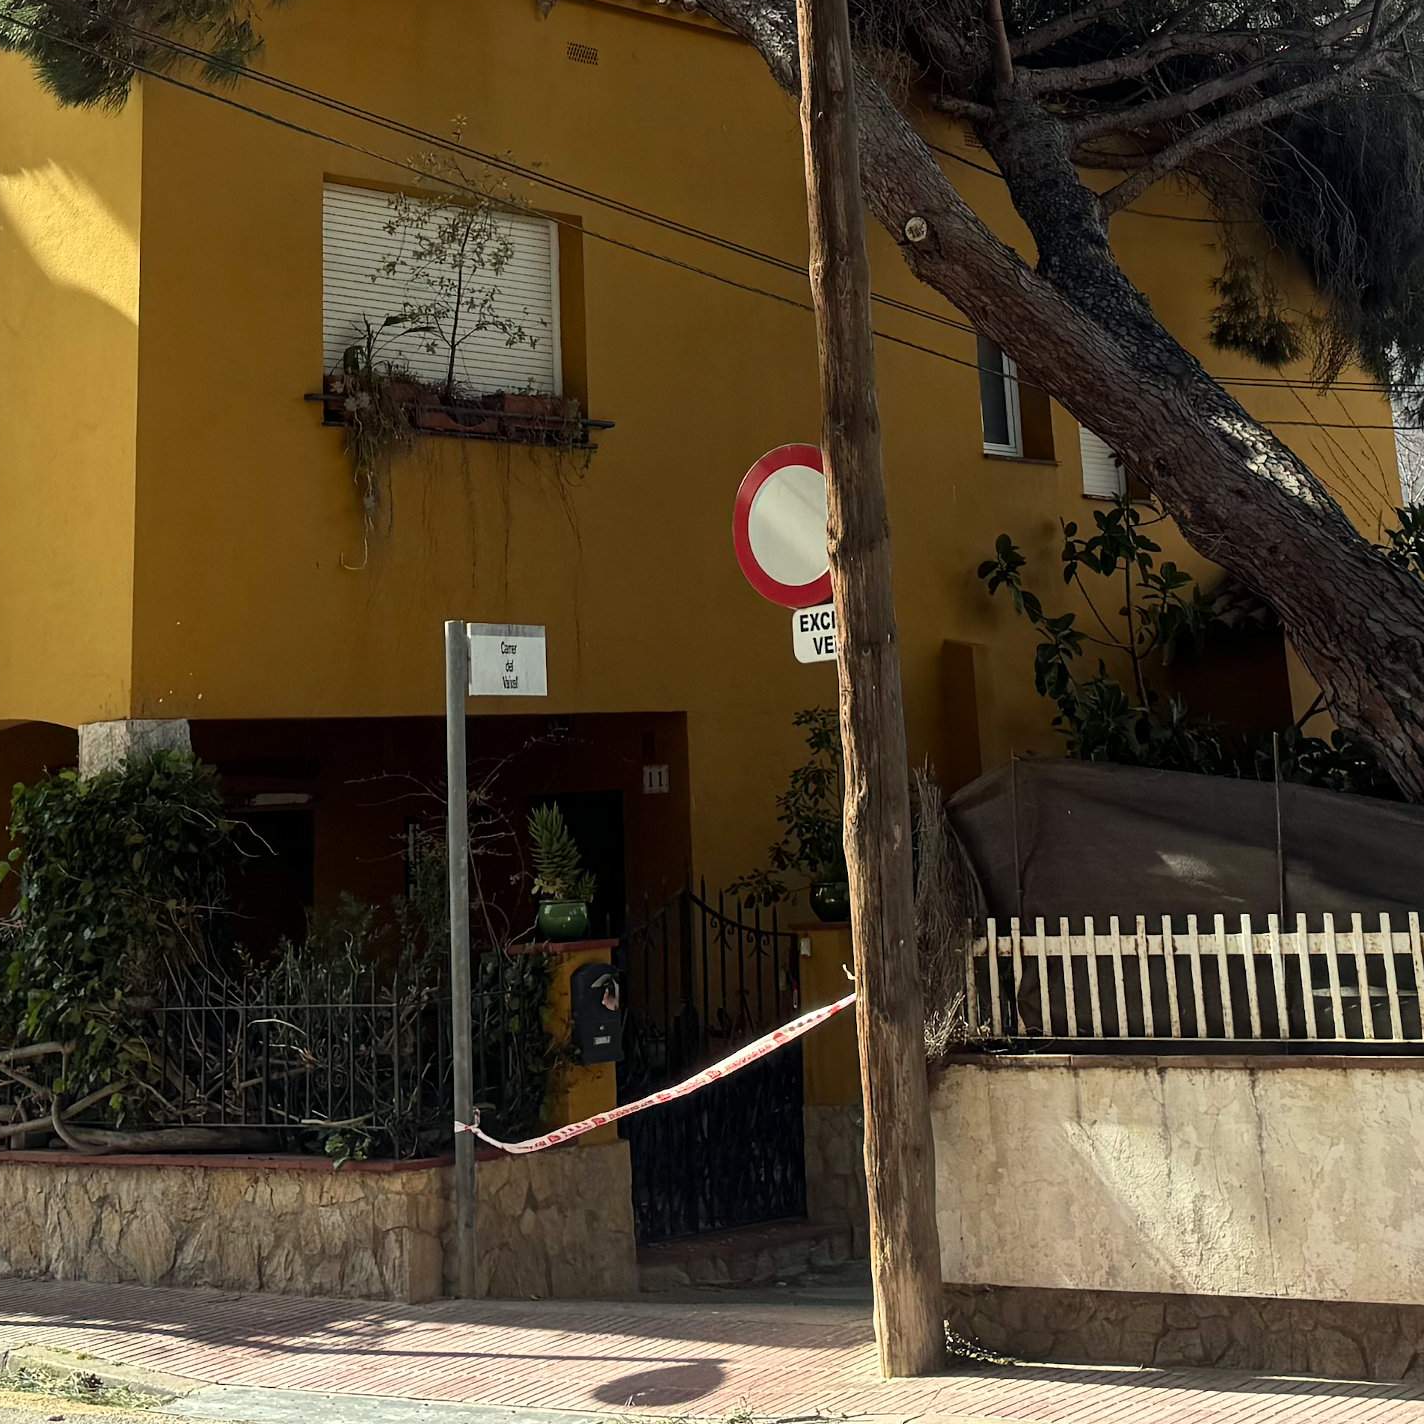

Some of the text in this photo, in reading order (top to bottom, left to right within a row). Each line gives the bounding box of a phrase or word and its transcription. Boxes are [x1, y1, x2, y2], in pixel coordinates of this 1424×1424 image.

[500, 641, 517, 654] Carrer
[812, 635, 837, 655] VE
[505, 659, 514, 672] del
[648, 771, 663, 787] 11
